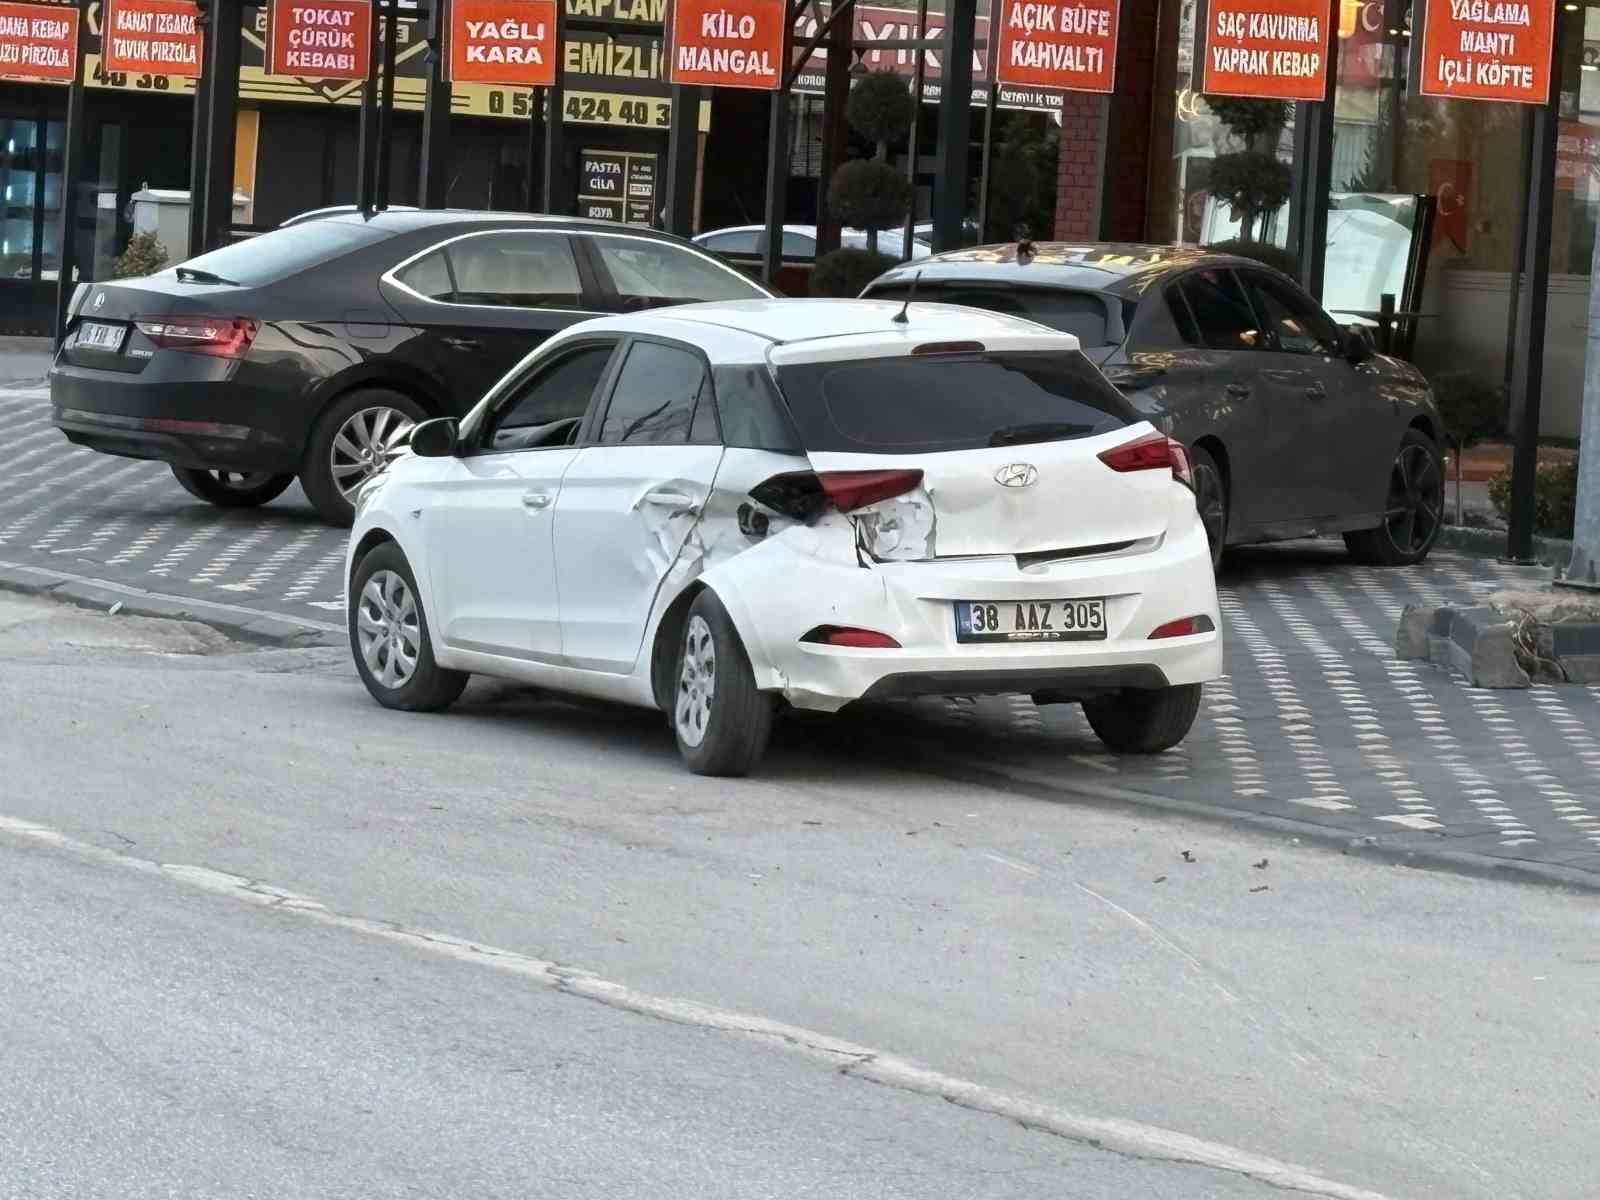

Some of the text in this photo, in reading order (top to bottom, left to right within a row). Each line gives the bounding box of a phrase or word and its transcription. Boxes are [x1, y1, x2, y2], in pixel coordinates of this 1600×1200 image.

[31, 19, 70, 40] KEBAP
[117, 10, 196, 35] KANAT IZGARA
[292, 8, 355, 26] TOKAT
[465, 18, 545, 41] YAĞLI
[701, 9, 756, 39] KİLO
[1009, 2, 1110, 36] AÇIK BÜFE
[1215, 11, 1319, 44] SAÇ KAVURMA
[113, 38, 149, 61] TAVUK
[289, 27, 355, 49] ÇÜRÜK
[1460, 30, 1515, 56] MANTI
[21, 42, 70, 67] PİRZOLA
[286, 51, 355, 70] KEBABI
[466, 45, 543, 65] KARA
[564, 36, 665, 80] EMİZLİ
[679, 46, 775, 75] MANGAL
[1011, 40, 1104, 74] KAHVALTI
[1212, 47, 1320, 77] YAPRAK KEBAP
[1438, 54, 1533, 88] İÇLİ KÖFTE
[566, 97, 612, 121] 424
[619, 101, 643, 125] 40
[585, 161, 621, 173] PASTA
[973, 603, 1102, 631] 38 AAZ 305
